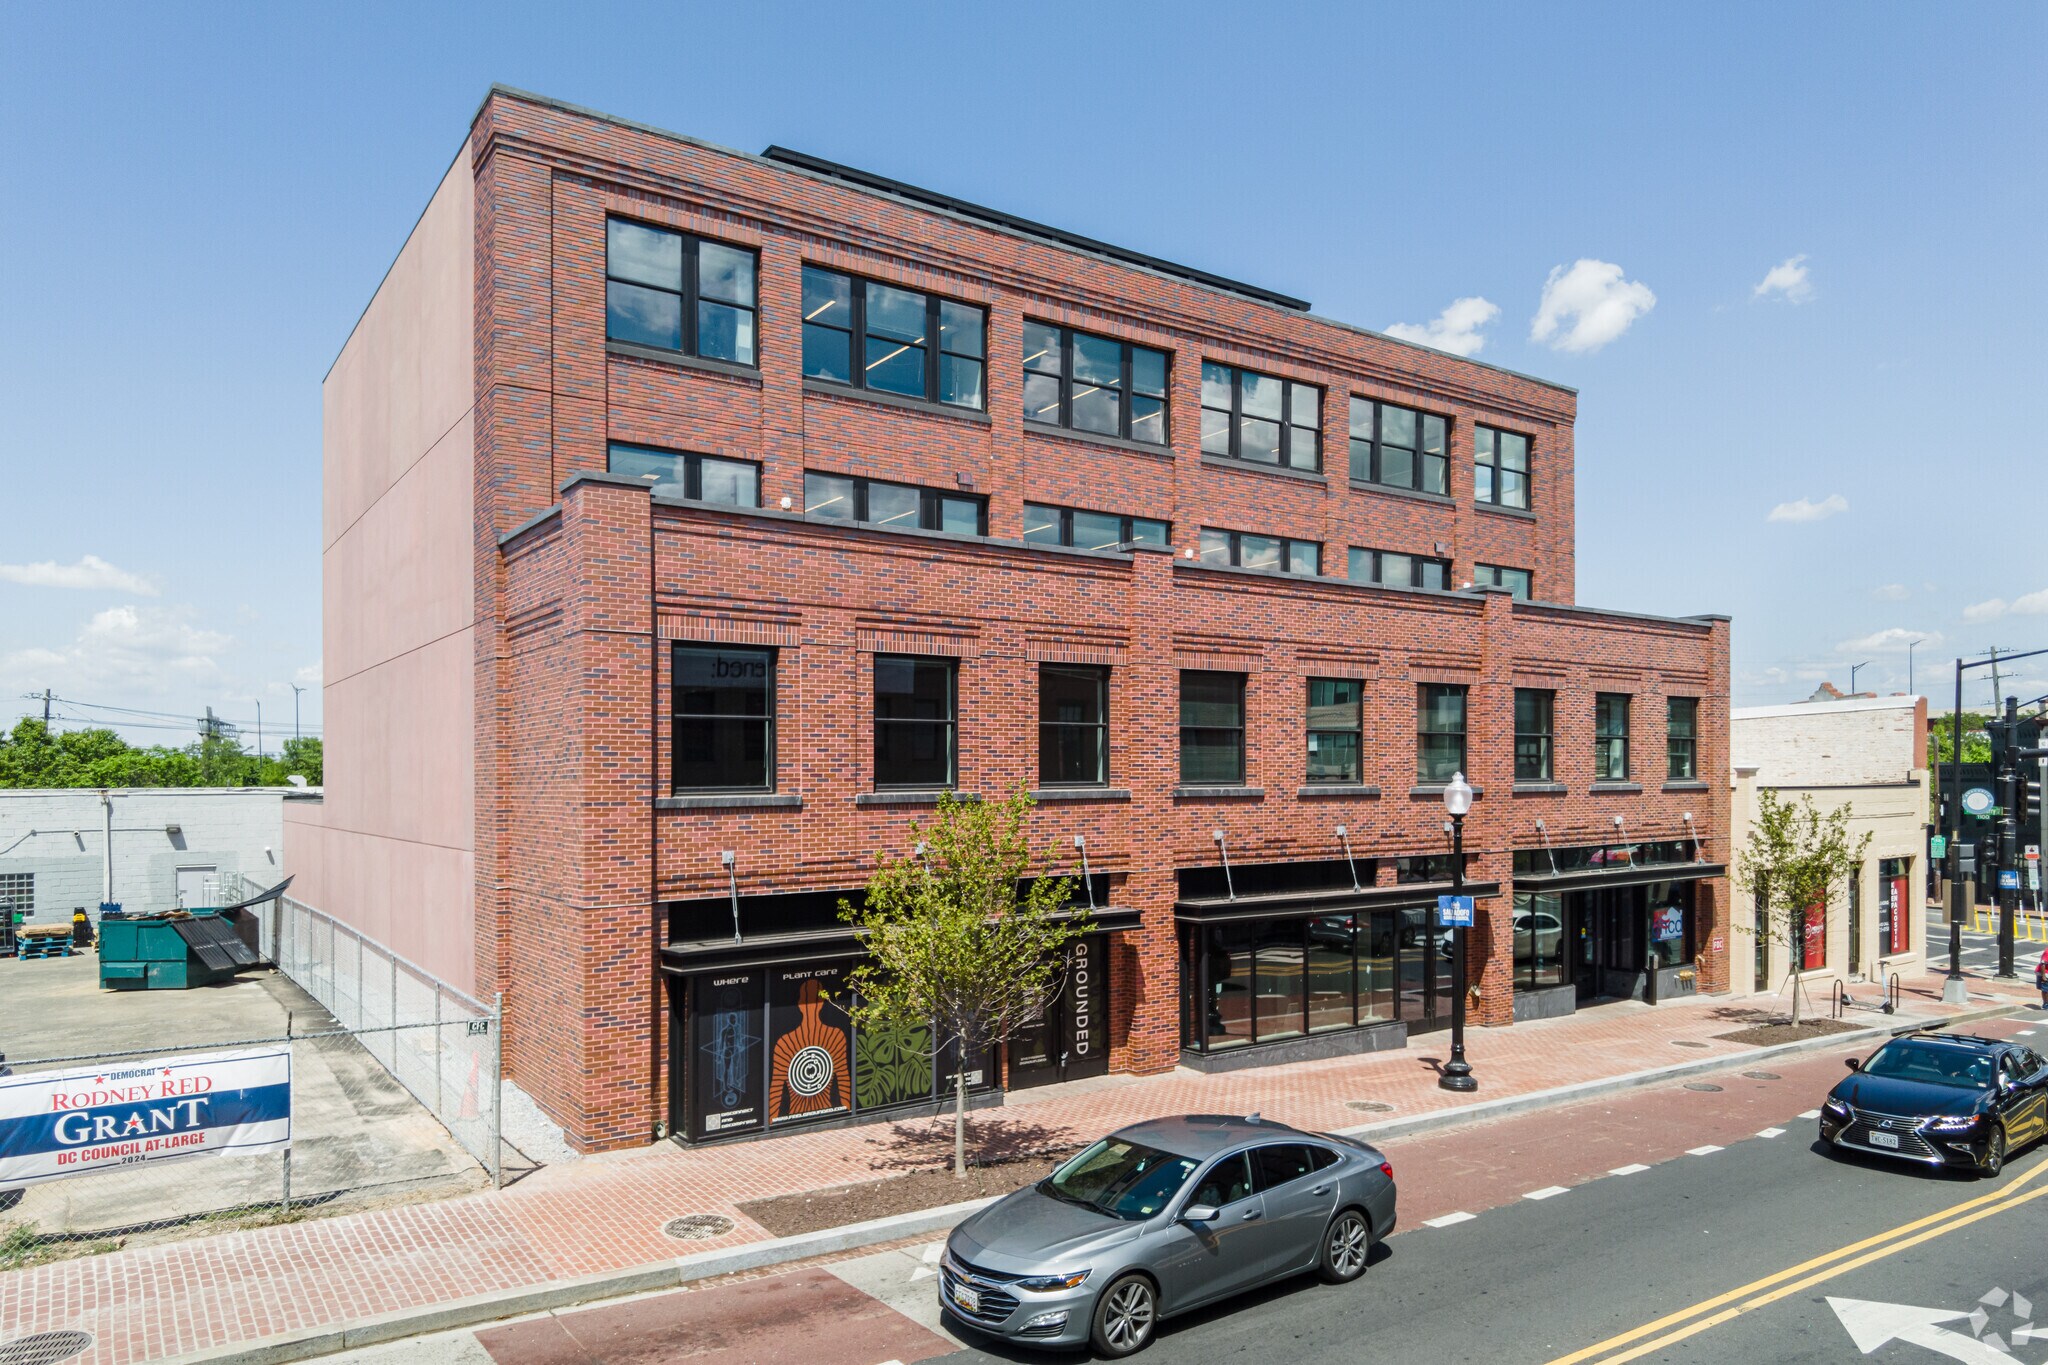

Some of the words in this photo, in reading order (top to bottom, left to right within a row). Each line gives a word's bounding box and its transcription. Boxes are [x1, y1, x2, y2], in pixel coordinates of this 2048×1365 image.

[1075, 943, 1089, 1055] GROUNDED
[110, 1068, 157, 1081] DEMOCRAT
[52, 1084, 154, 1111] RODNEY
[161, 1076, 212, 1100] RED
[54, 1097, 209, 1145] GRANT
[57, 1151, 78, 1165] DC
[81, 1142, 141, 1162] COUNCIL
[145, 1132, 205, 1151] AT-LARGE
[121, 1154, 146, 1165] 2024
